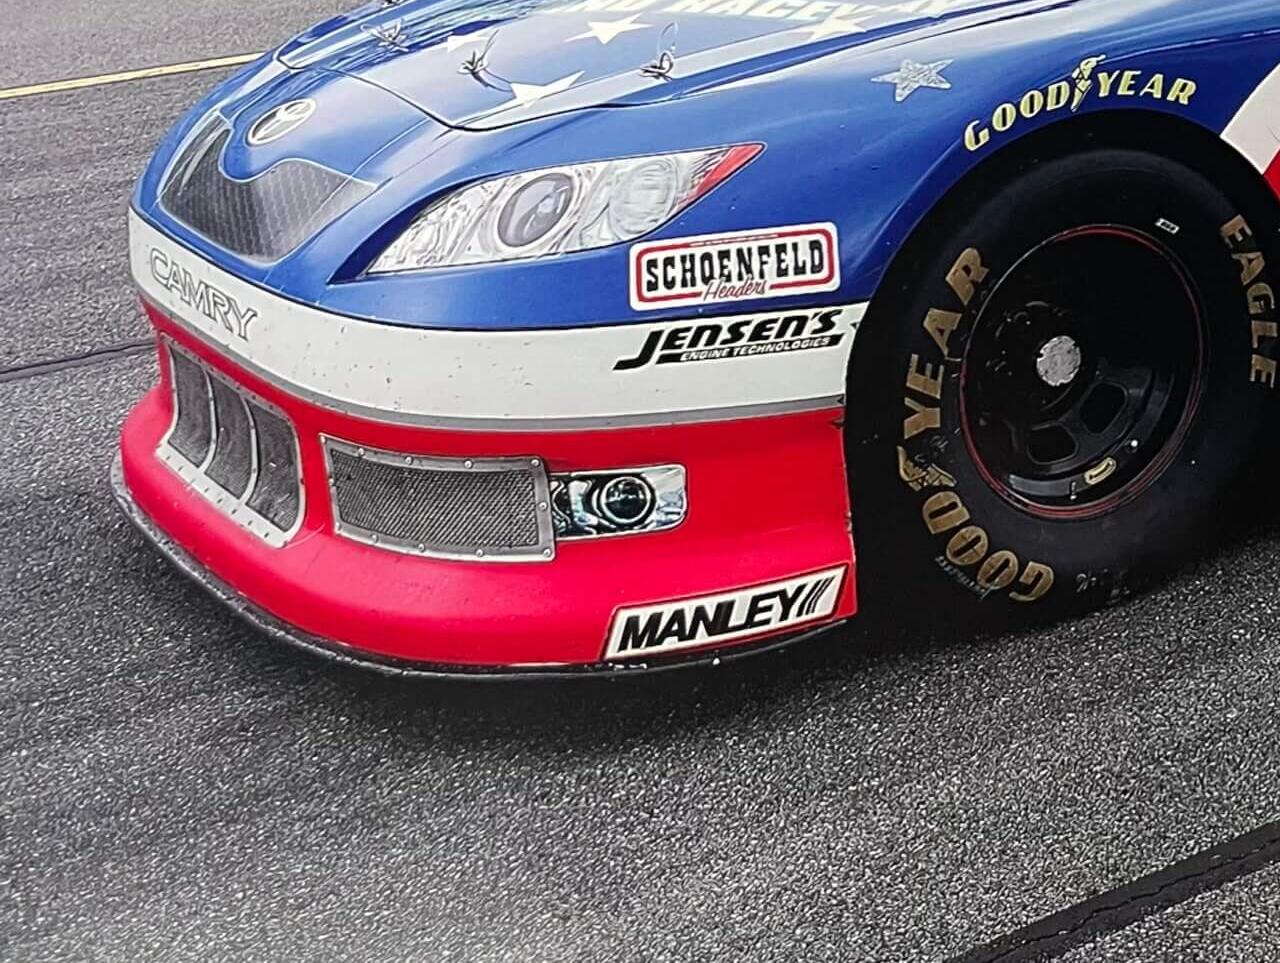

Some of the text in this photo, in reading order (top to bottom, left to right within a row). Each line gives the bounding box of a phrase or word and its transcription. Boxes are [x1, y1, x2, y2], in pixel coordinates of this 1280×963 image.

[150, 247, 258, 342] CAMRY
[646, 239, 824, 292] SCHOENFELD
[703, 275, 767, 301] Headers
[1220, 214, 1278, 389] EAGLE
[680, 336, 831, 362] ENGINE TECHNOLOGIES
[617, 583, 808, 653] MANLEY
